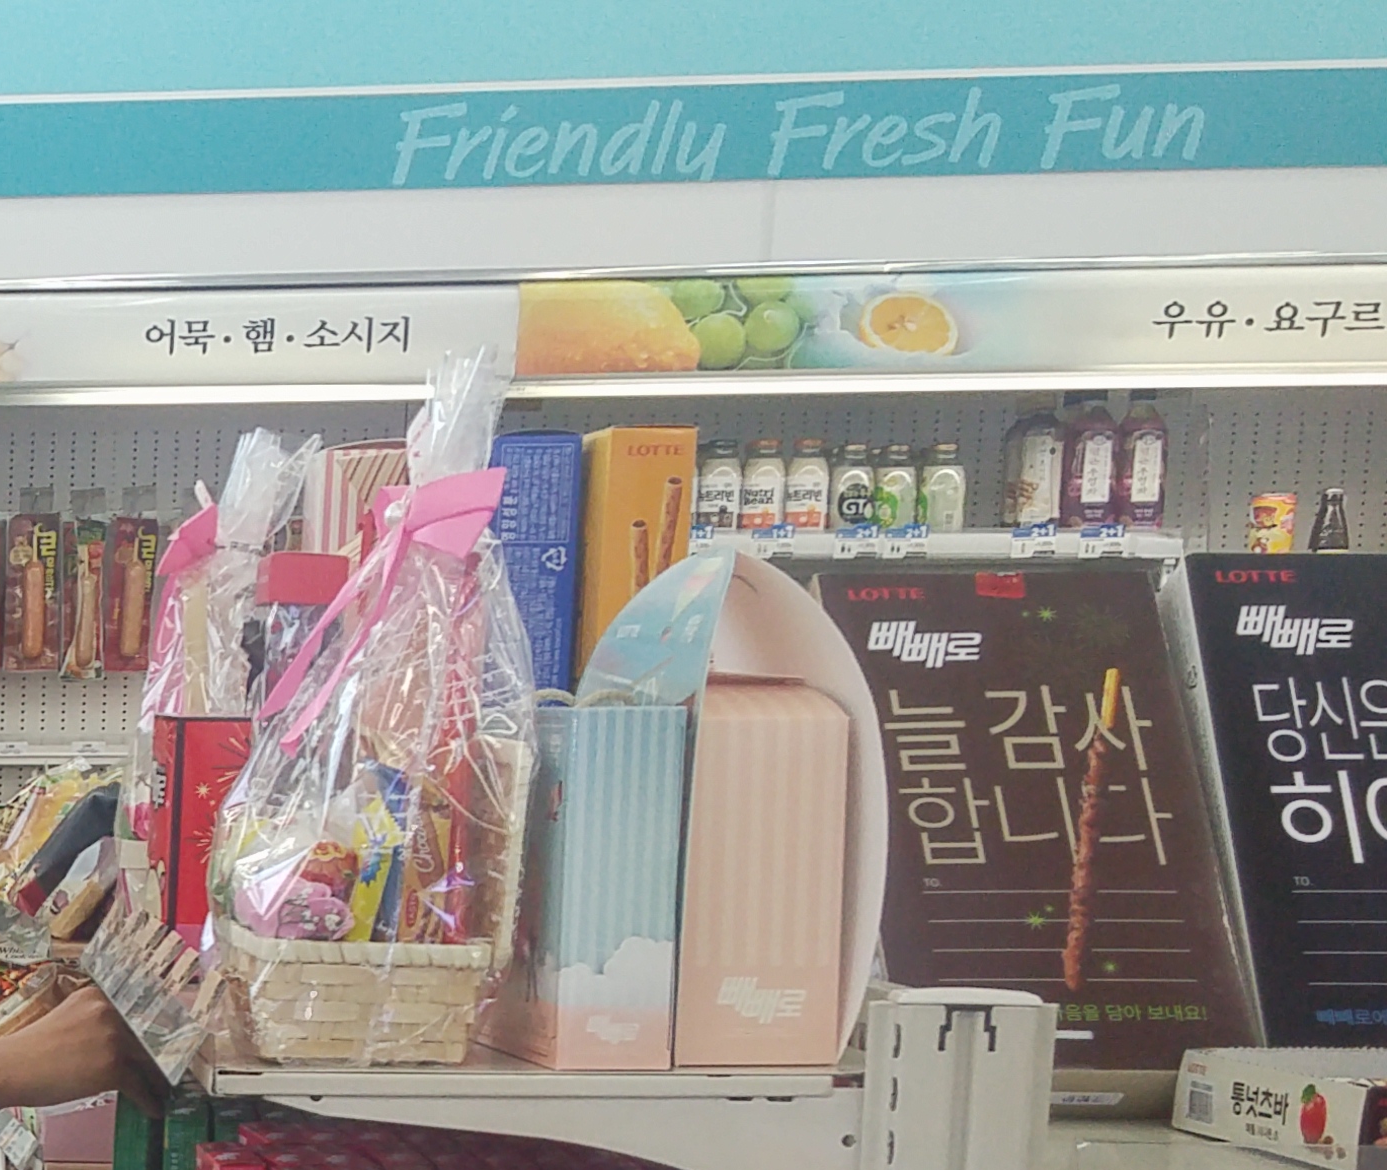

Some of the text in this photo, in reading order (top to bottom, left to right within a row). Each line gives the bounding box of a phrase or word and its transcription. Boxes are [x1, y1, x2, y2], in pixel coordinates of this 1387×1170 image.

[391, 83, 1205, 187] Friendly Fresh Fun
[627, 444, 684, 457] LOTTE
[743, 487, 775, 499] Nutri
[856, 525, 878, 538] 2+1
[905, 525, 927, 538] 2+1
[1031, 525, 1056, 538] 2+1
[1100, 525, 1125, 538] 2+1
[1215, 569, 1296, 583] LOTTE
[847, 587, 925, 600] LOTTE
[1237, 604, 1355, 655] 빼빼로
[868, 620, 982, 668] 빼빼로
[883, 685, 1152, 771] 늘 감사
[898, 777, 1173, 865] 합니다
[1271, 771, 1387, 864] 히
[1056, 1004, 1208, 1022] 음을 담아 보내요!
[1230, 1081, 1290, 1126] 통넛츠바
